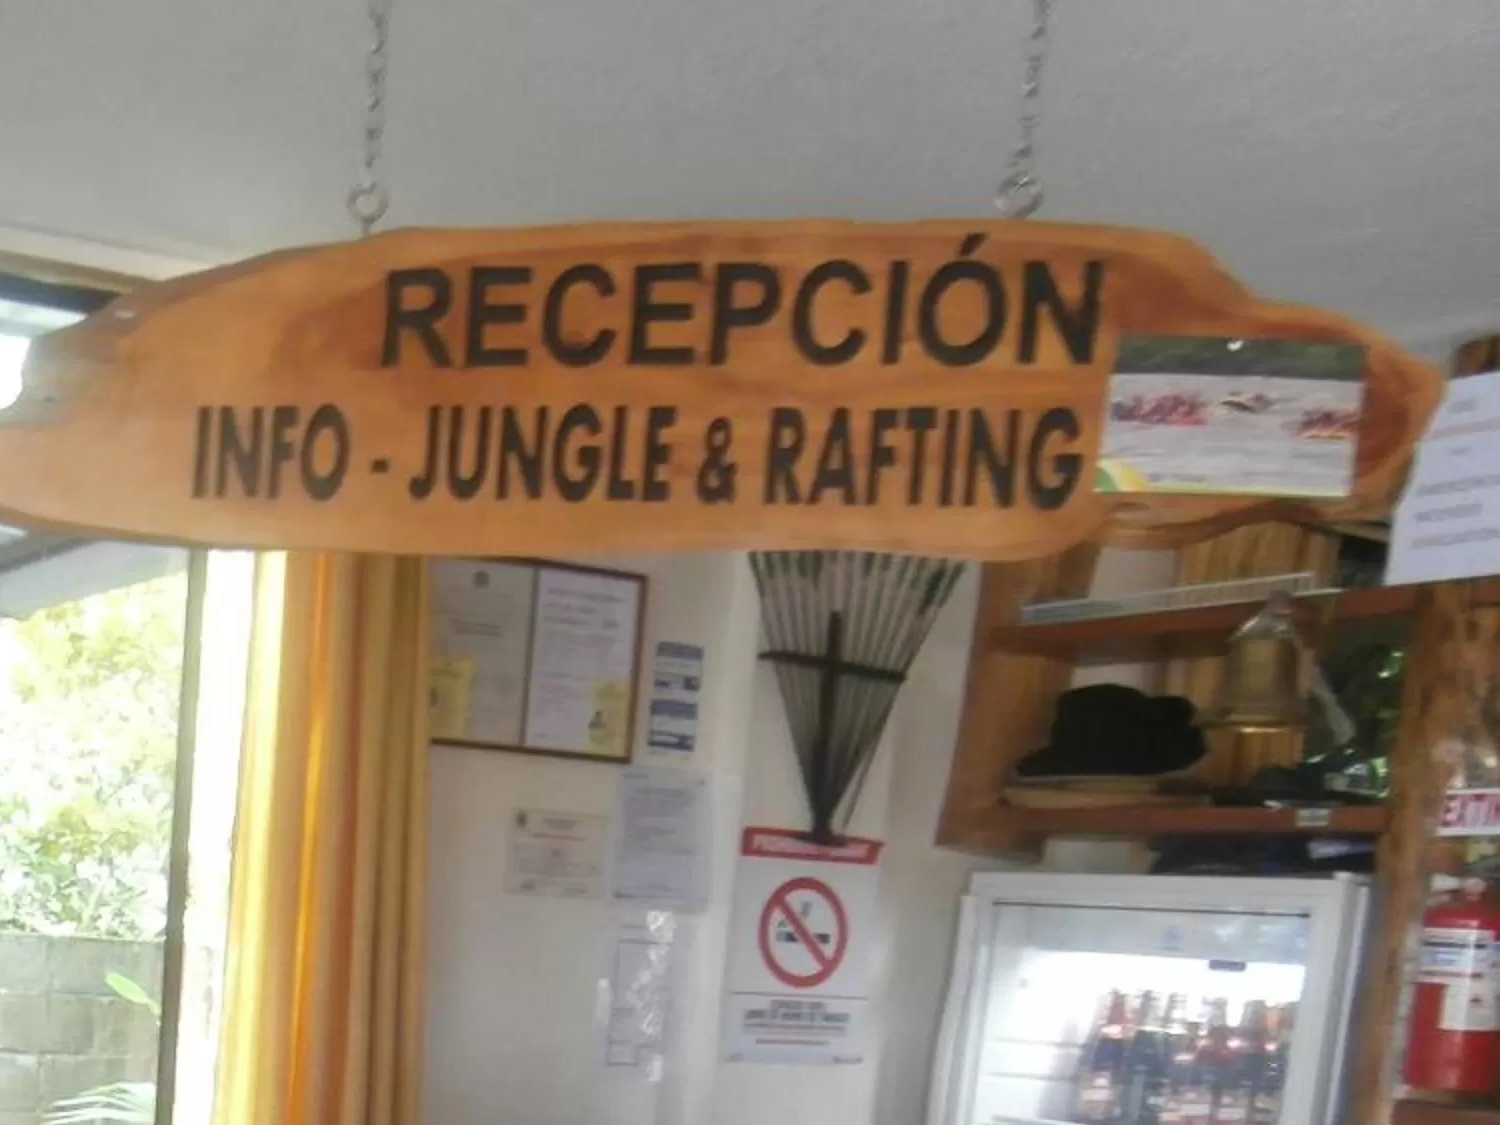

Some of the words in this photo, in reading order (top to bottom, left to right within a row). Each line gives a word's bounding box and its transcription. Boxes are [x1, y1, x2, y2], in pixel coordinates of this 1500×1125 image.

[380, 233, 1107, 368] RECEPCIÓN
[193, 403, 351, 501] INFO
[409, 403, 677, 503] JUNGLE
[697, 416, 737, 504] &
[763, 407, 1085, 510] RAFTING
